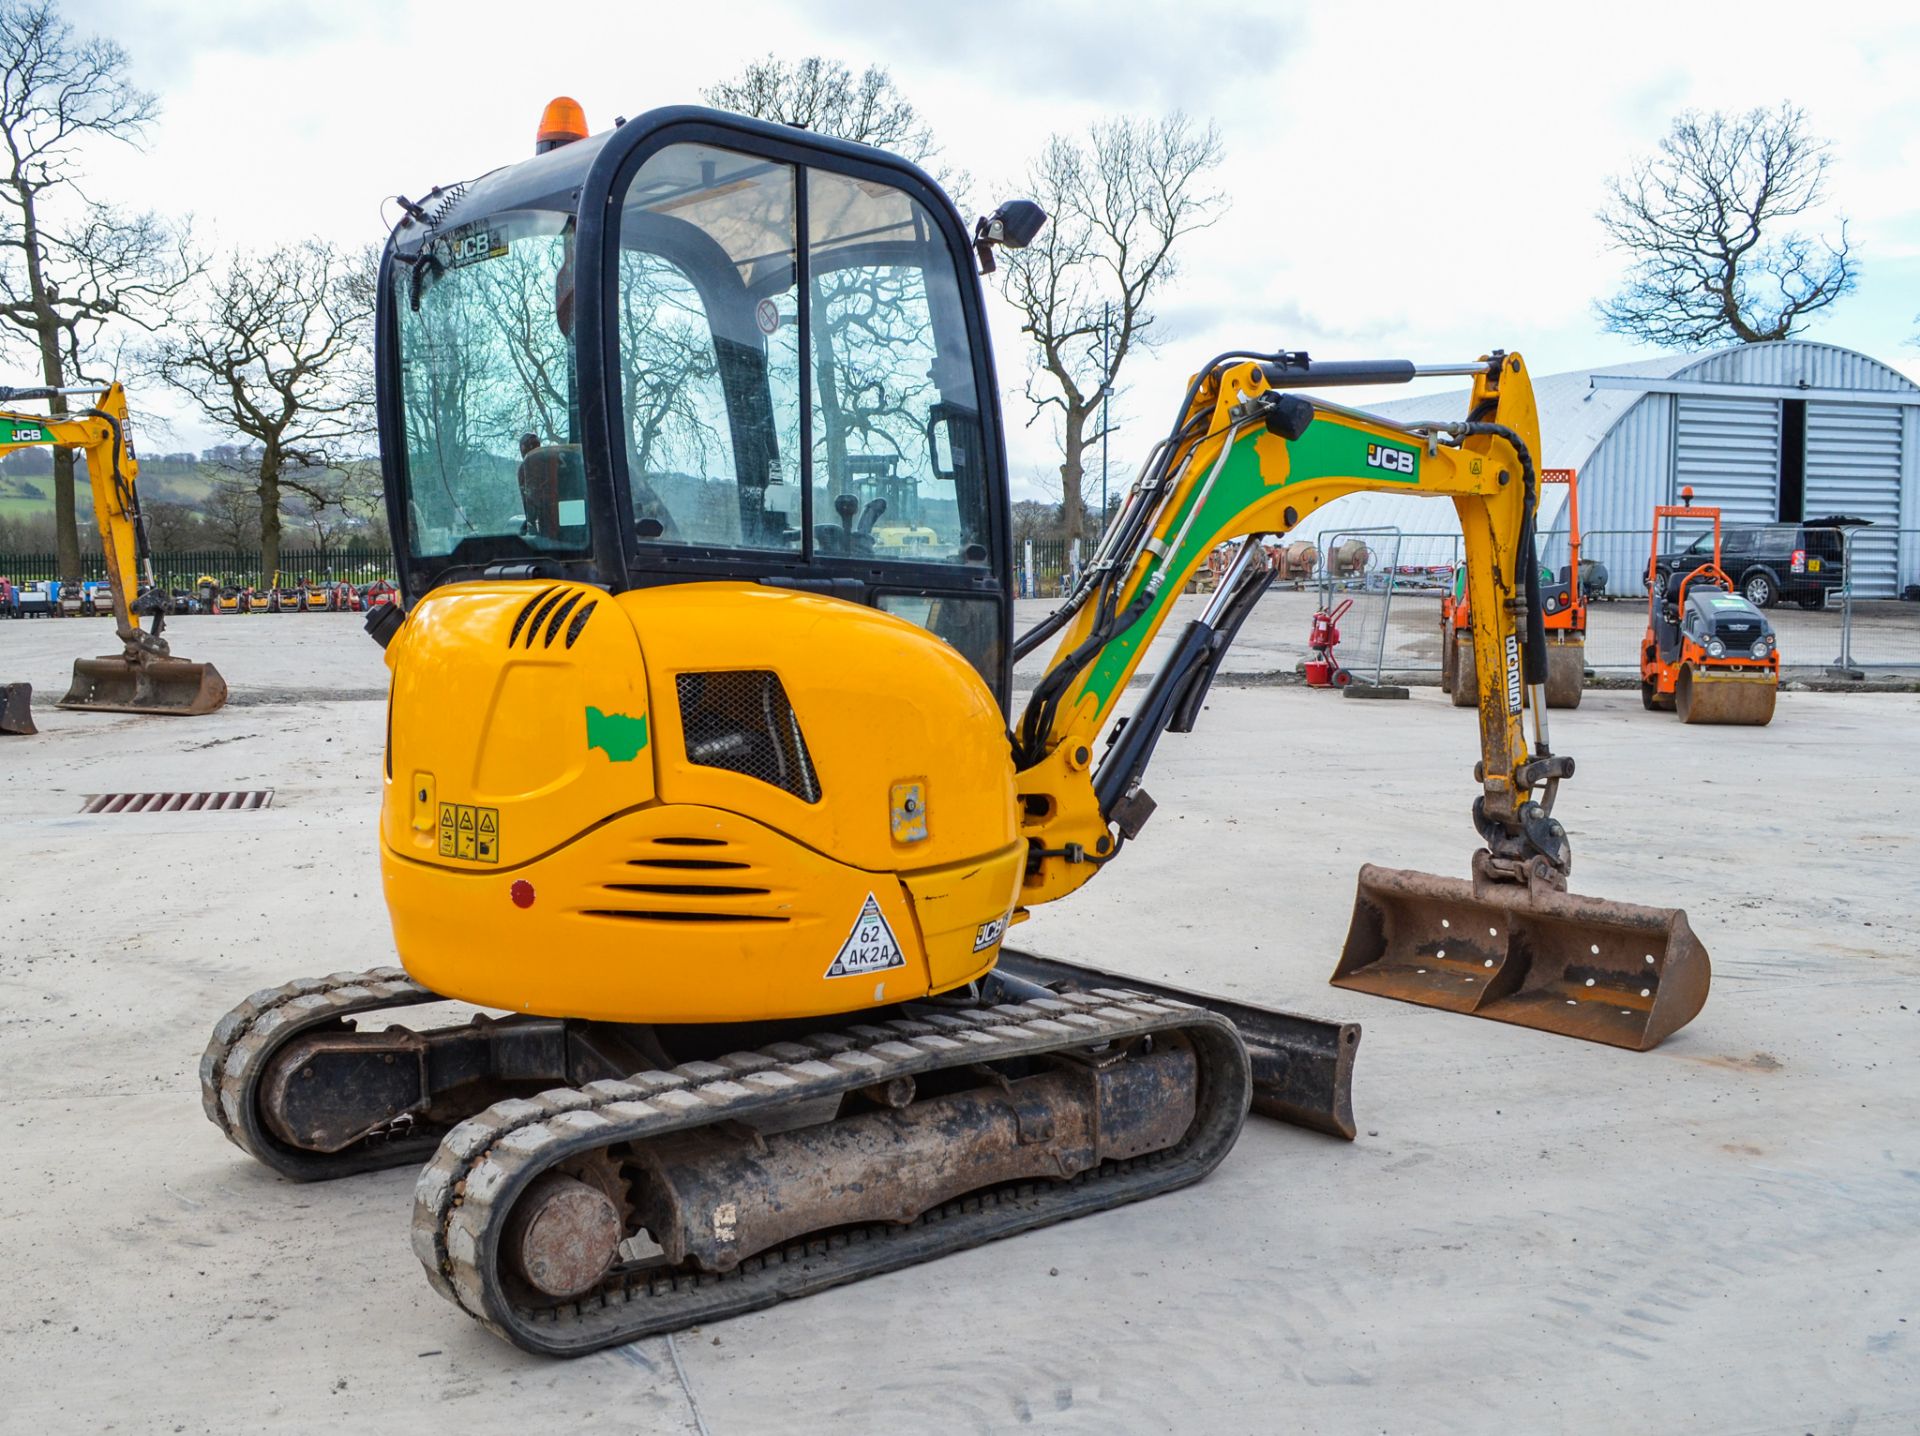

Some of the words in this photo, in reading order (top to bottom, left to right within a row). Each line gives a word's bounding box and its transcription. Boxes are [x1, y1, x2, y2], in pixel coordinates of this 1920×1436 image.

[11, 429, 42, 441] JCB
[1367, 444, 1414, 473] JCB
[1505, 635, 1520, 706] 8025
[860, 925, 880, 943] 62
[975, 918, 1003, 945] JCB
[848, 945, 889, 966] AK2A
